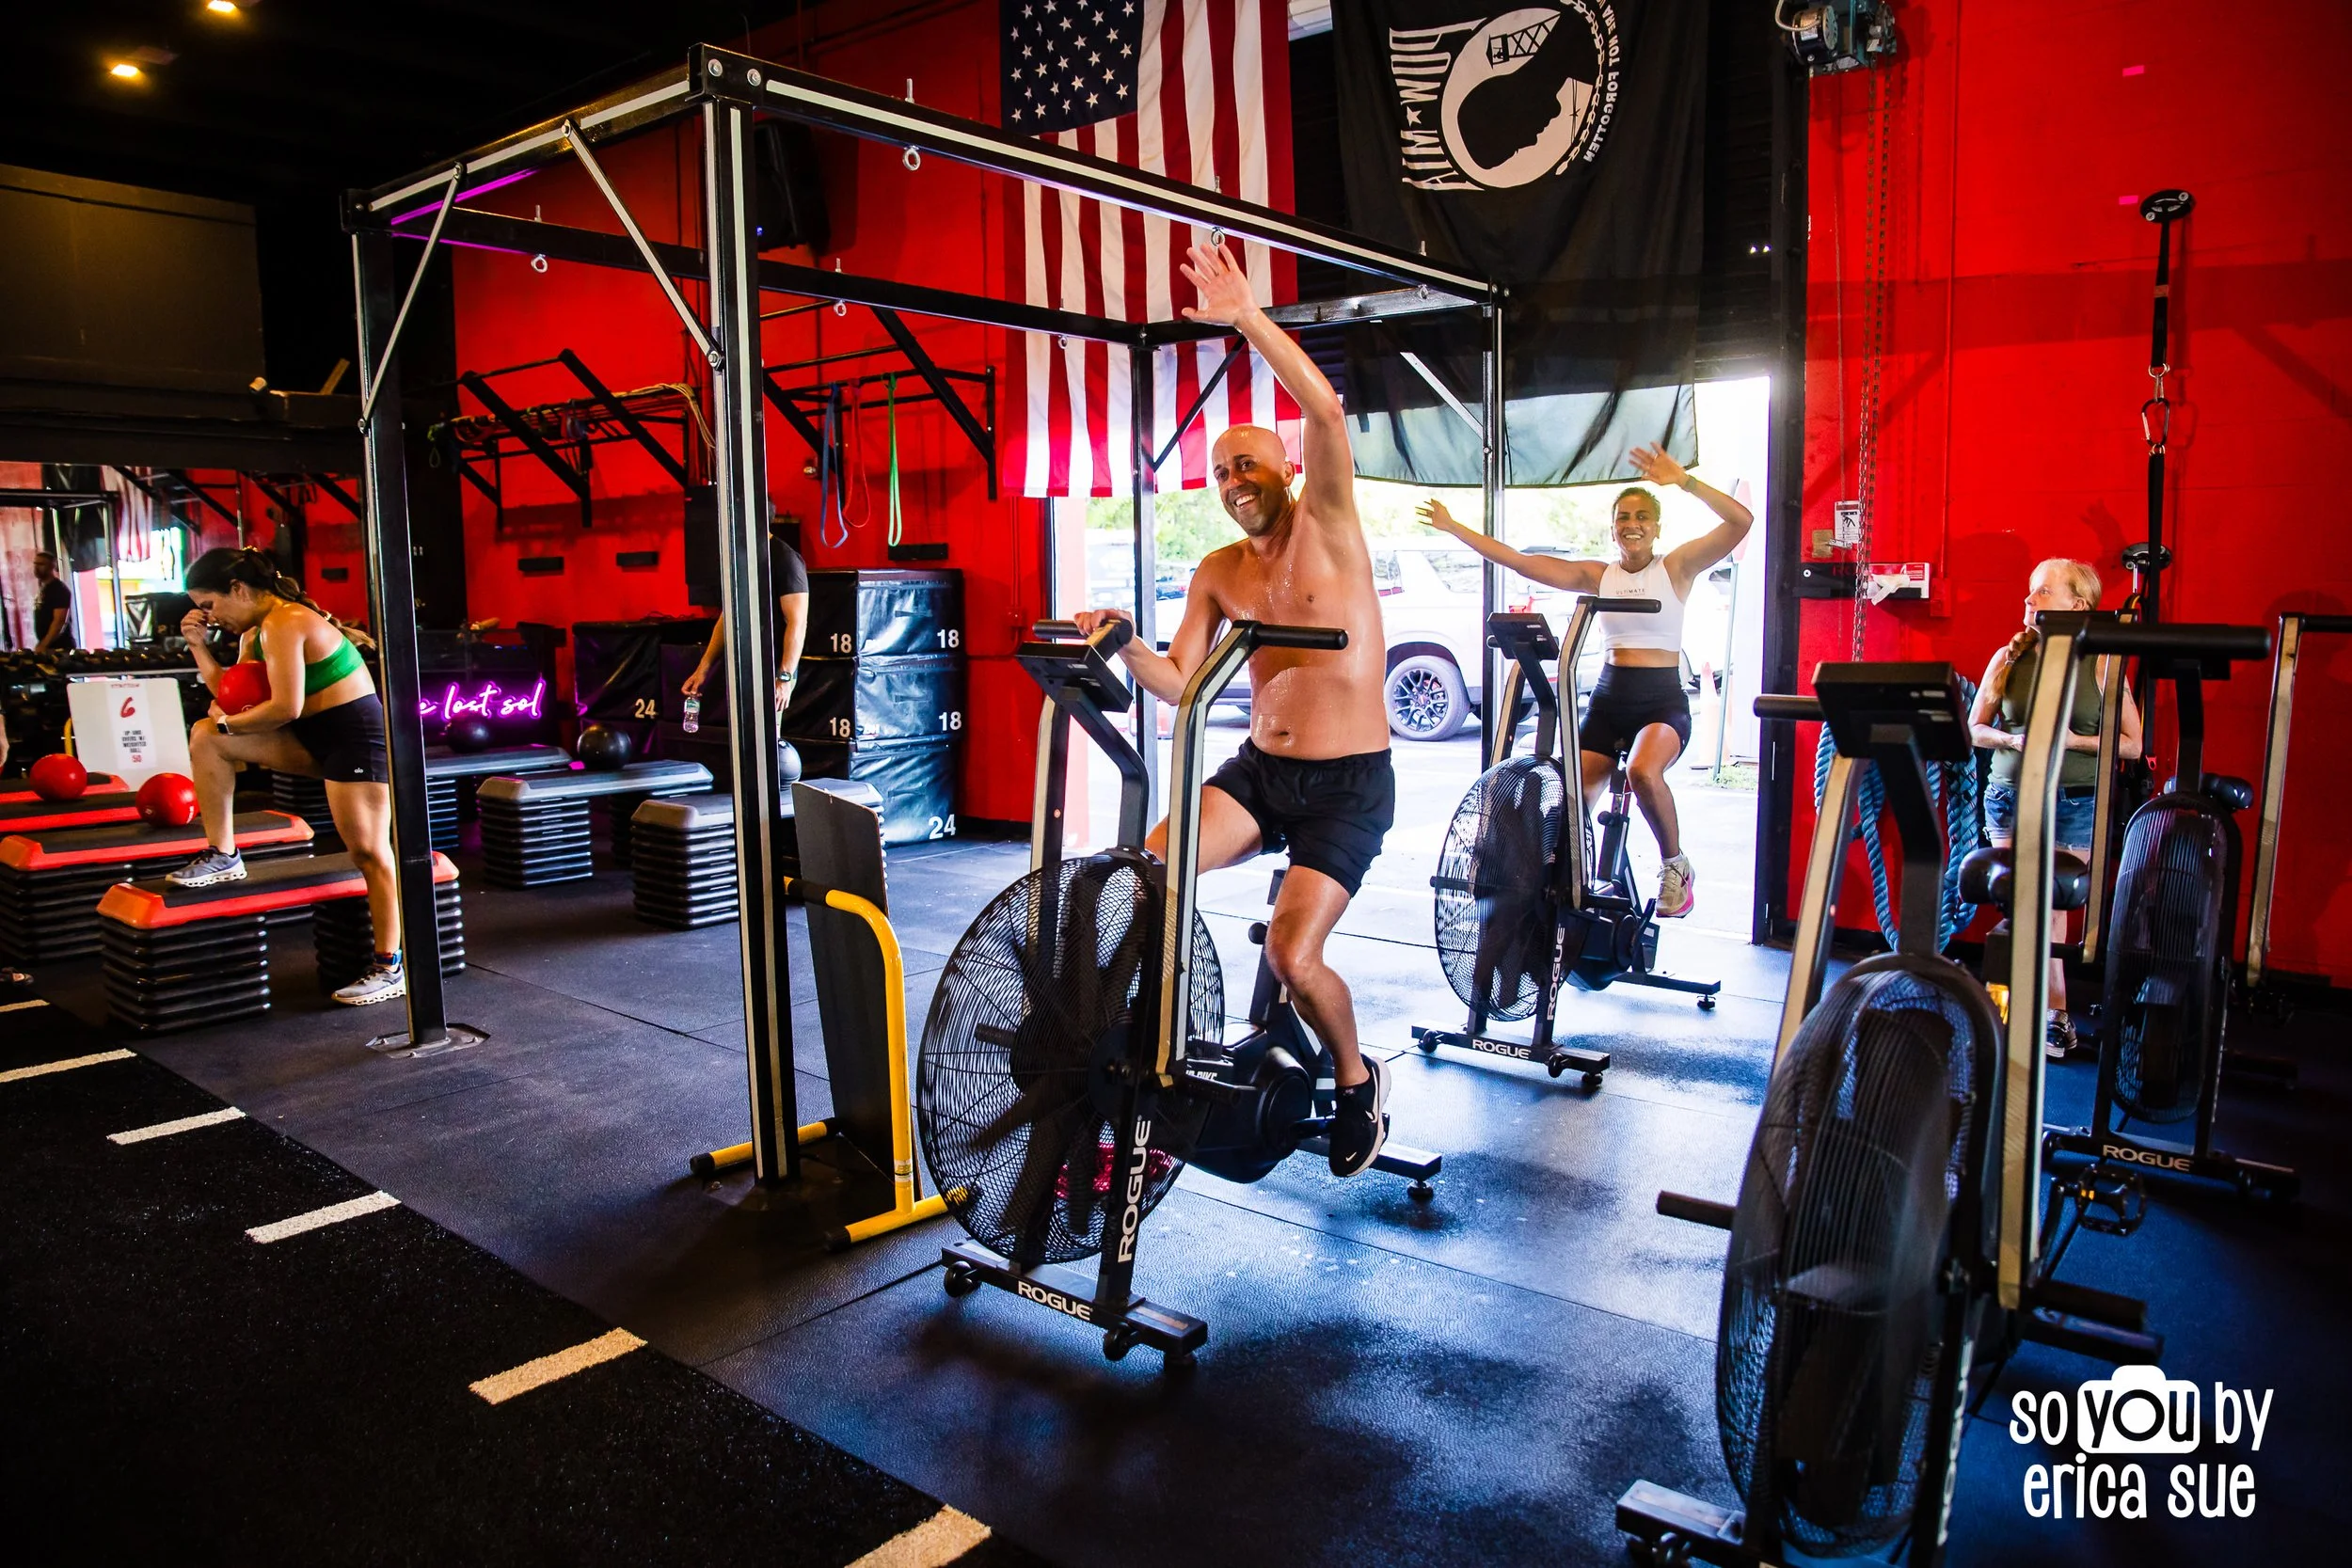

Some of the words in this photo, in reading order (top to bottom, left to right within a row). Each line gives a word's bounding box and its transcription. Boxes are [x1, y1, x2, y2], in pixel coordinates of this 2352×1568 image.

[830, 633, 852, 653] 18
[937, 629, 960, 648] 18
[119, 697, 135, 718] 6
[444, 684, 500, 720] lost
[500, 682, 544, 717] sol
[634, 699, 657, 719] 24
[830, 717, 850, 737] 18
[938, 711, 962, 731] 18
[928, 814, 956, 840] 24
[1547, 926, 1565, 1021] ROGUE
[1472, 1039, 1531, 1060] ROGUE
[2103, 1144, 2191, 1172] ROGUE
[1118, 1119, 1152, 1263] ROGUE
[1018, 1280, 1091, 1321] ROGUE
